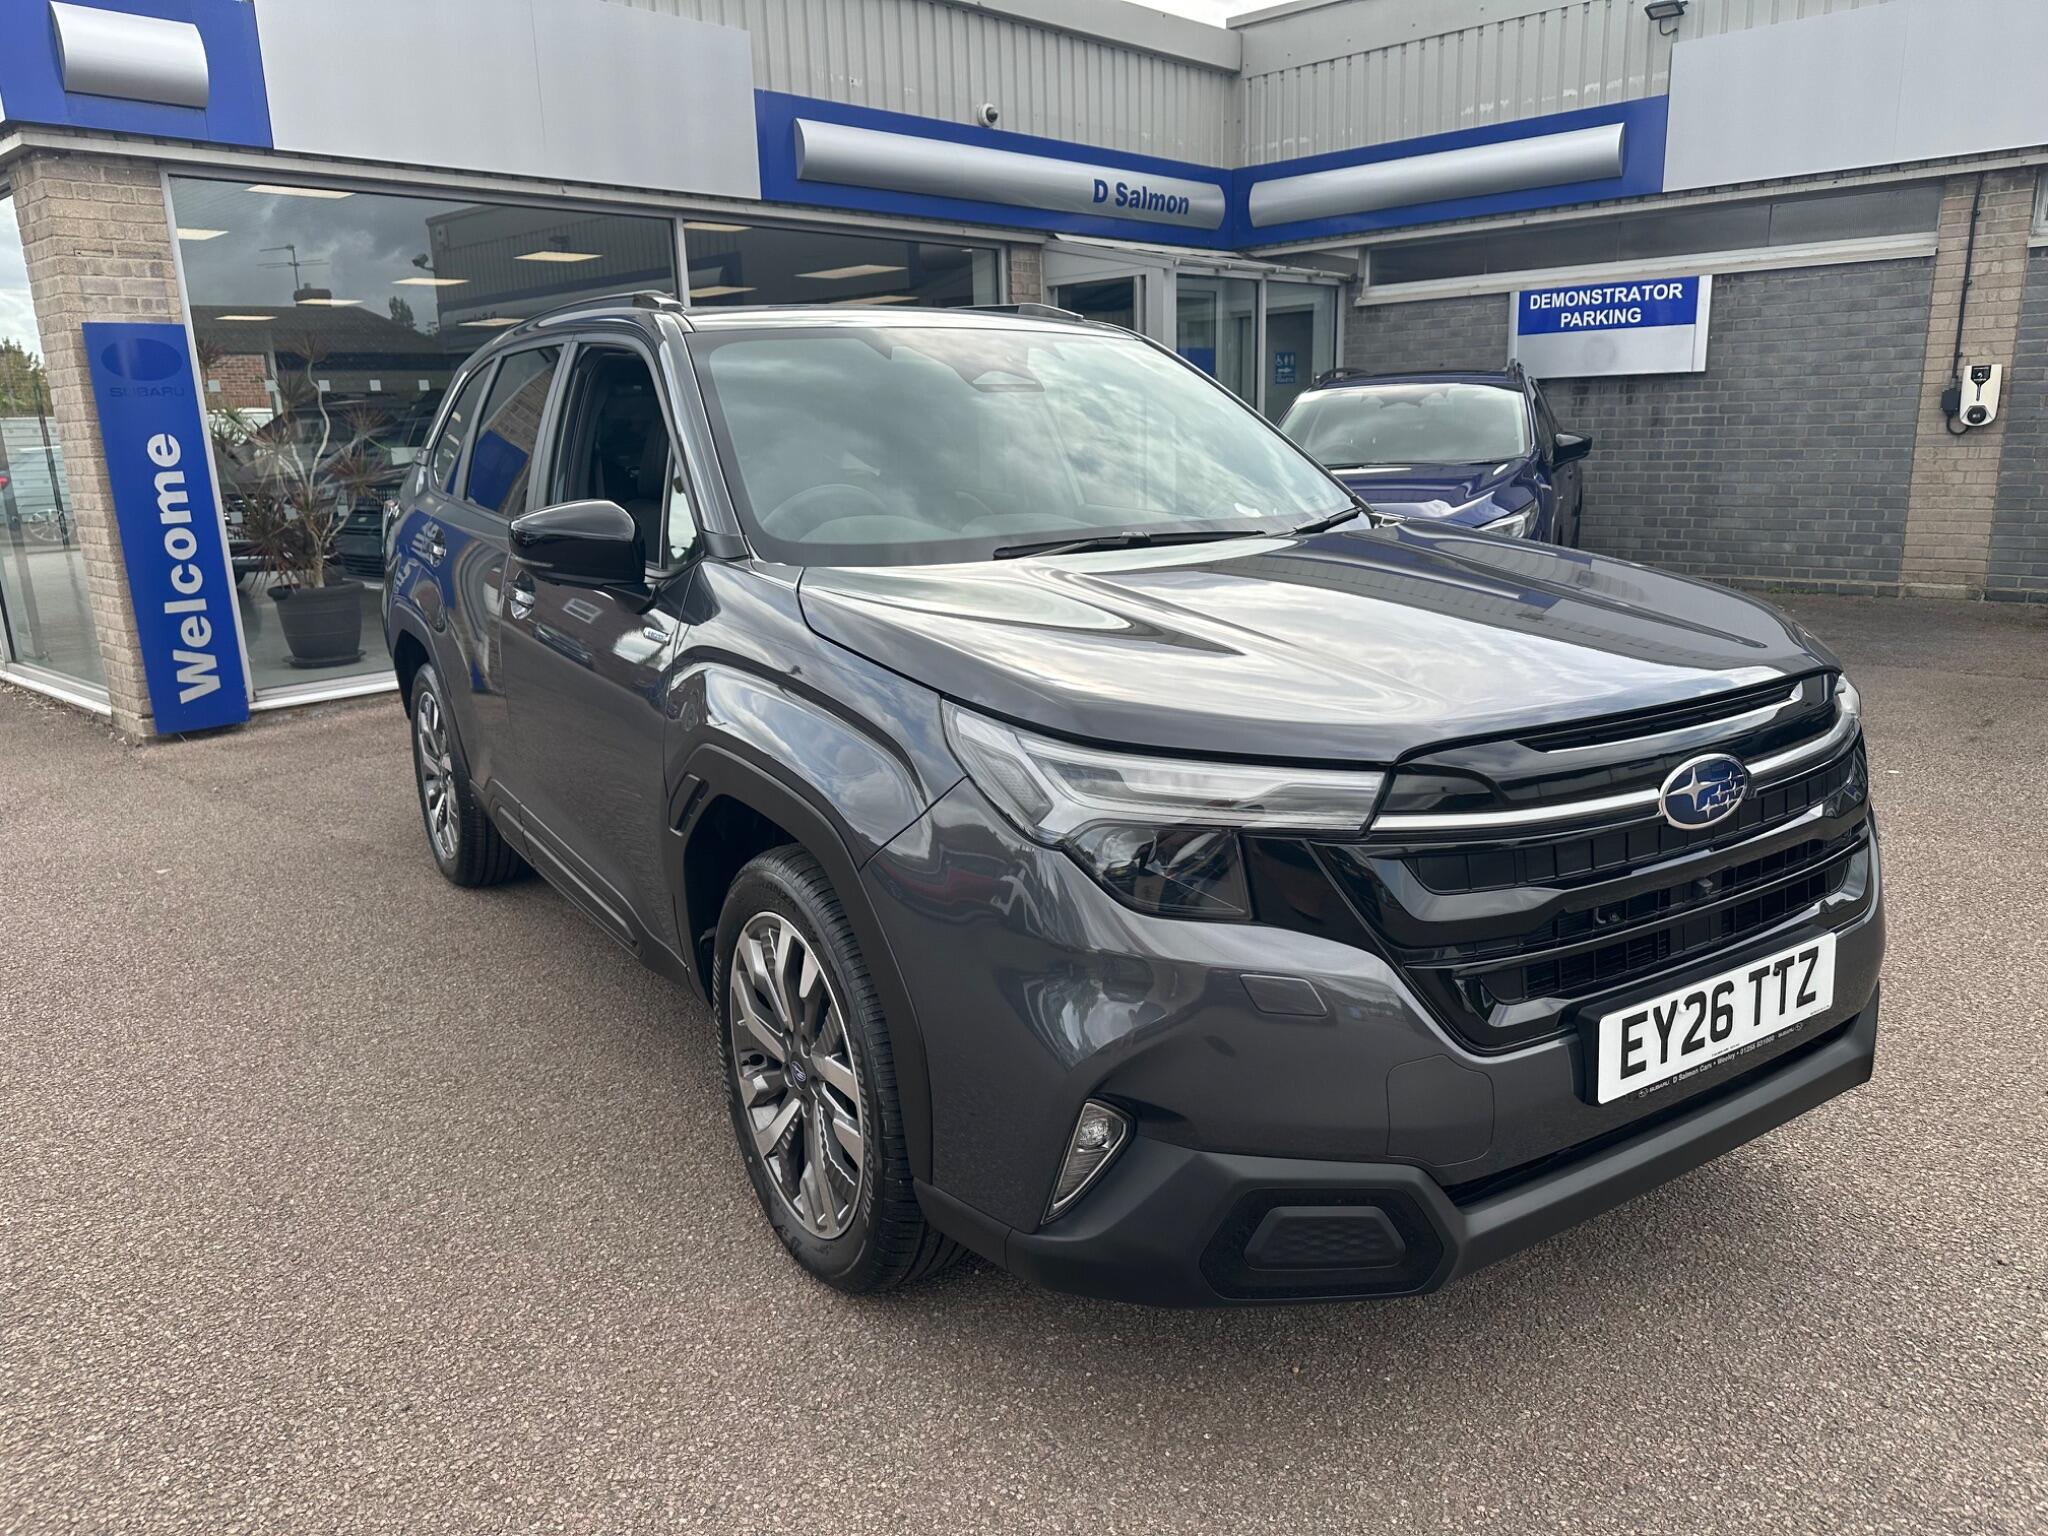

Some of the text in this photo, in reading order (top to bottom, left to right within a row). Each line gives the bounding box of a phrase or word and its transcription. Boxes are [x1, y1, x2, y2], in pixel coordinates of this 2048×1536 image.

[1093, 179, 1190, 215] D Salmon
[1530, 283, 1683, 310] DEMONSTRATOR
[1560, 307, 1642, 328] PARKING
[147, 433, 221, 704] Welcome
[1620, 946, 1819, 1080] EY26 TTZ
[1672, 1075, 1678, 1084] D
[1679, 1068, 1698, 1080] Salmon
[1700, 1062, 1713, 1073] Cars
